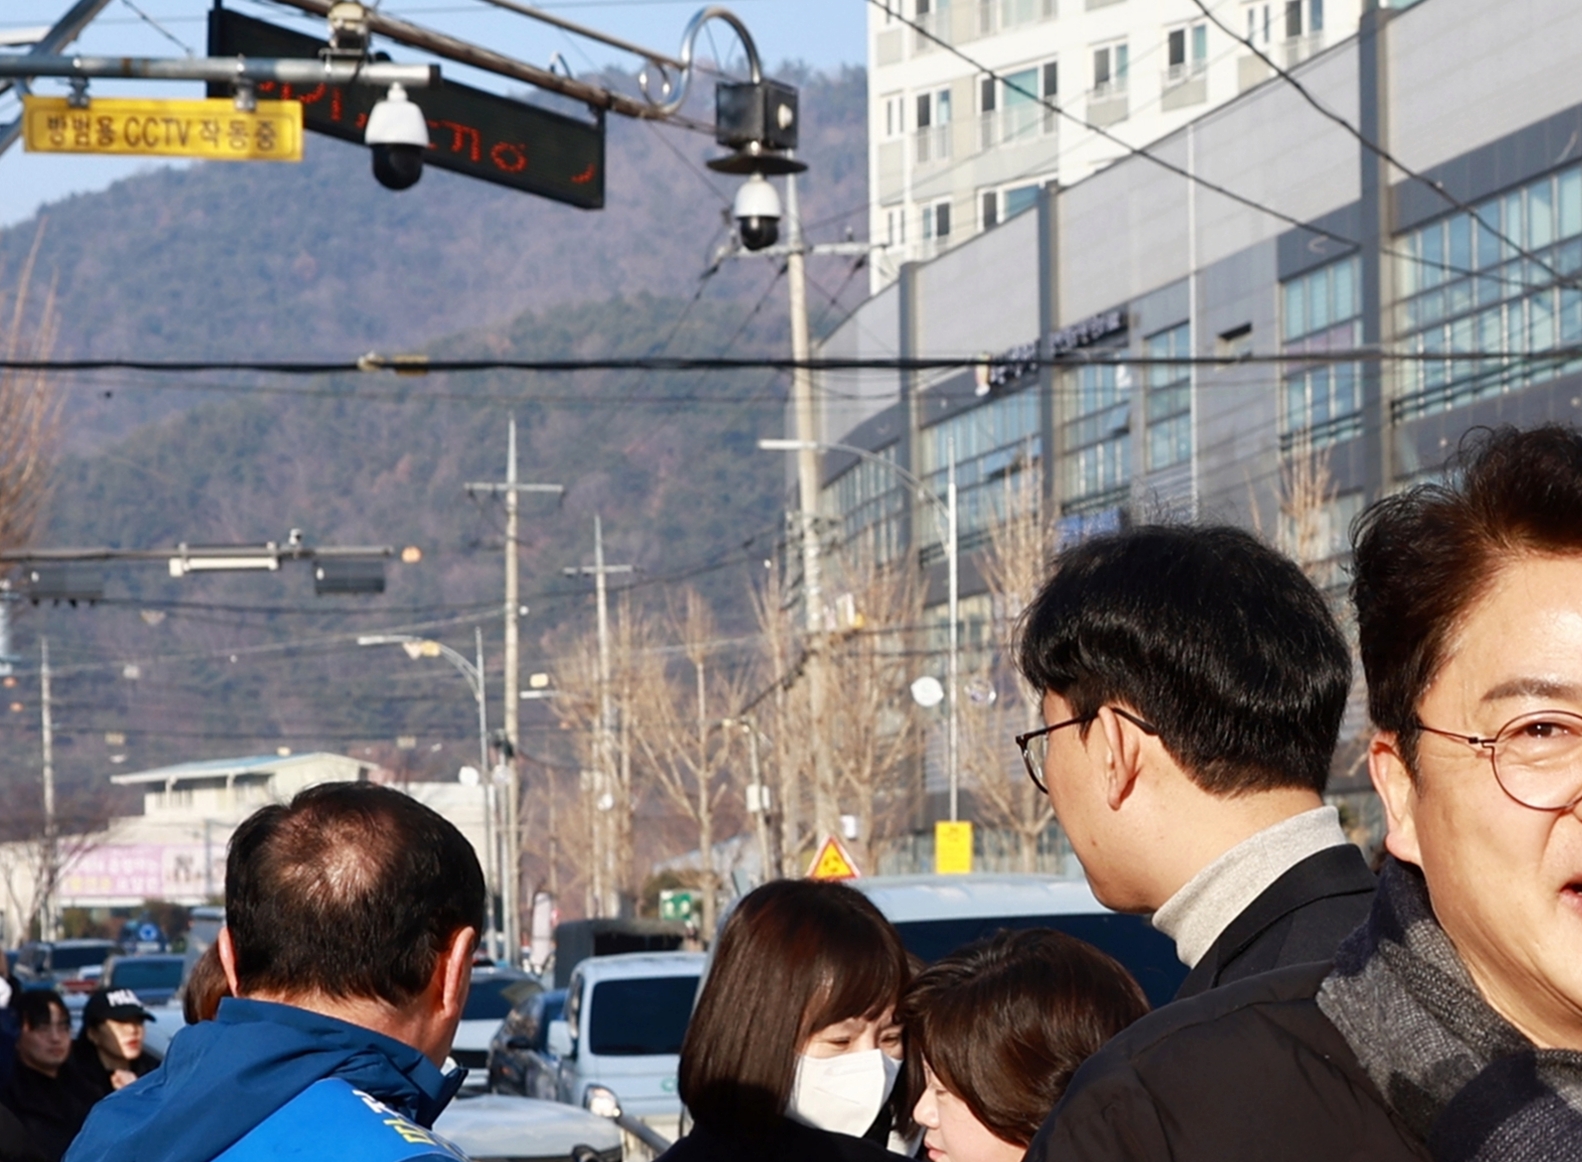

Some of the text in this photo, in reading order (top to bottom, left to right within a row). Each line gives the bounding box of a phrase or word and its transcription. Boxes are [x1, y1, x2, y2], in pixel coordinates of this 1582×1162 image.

[47, 115, 276, 151] 방범용 CCTV 작동중
